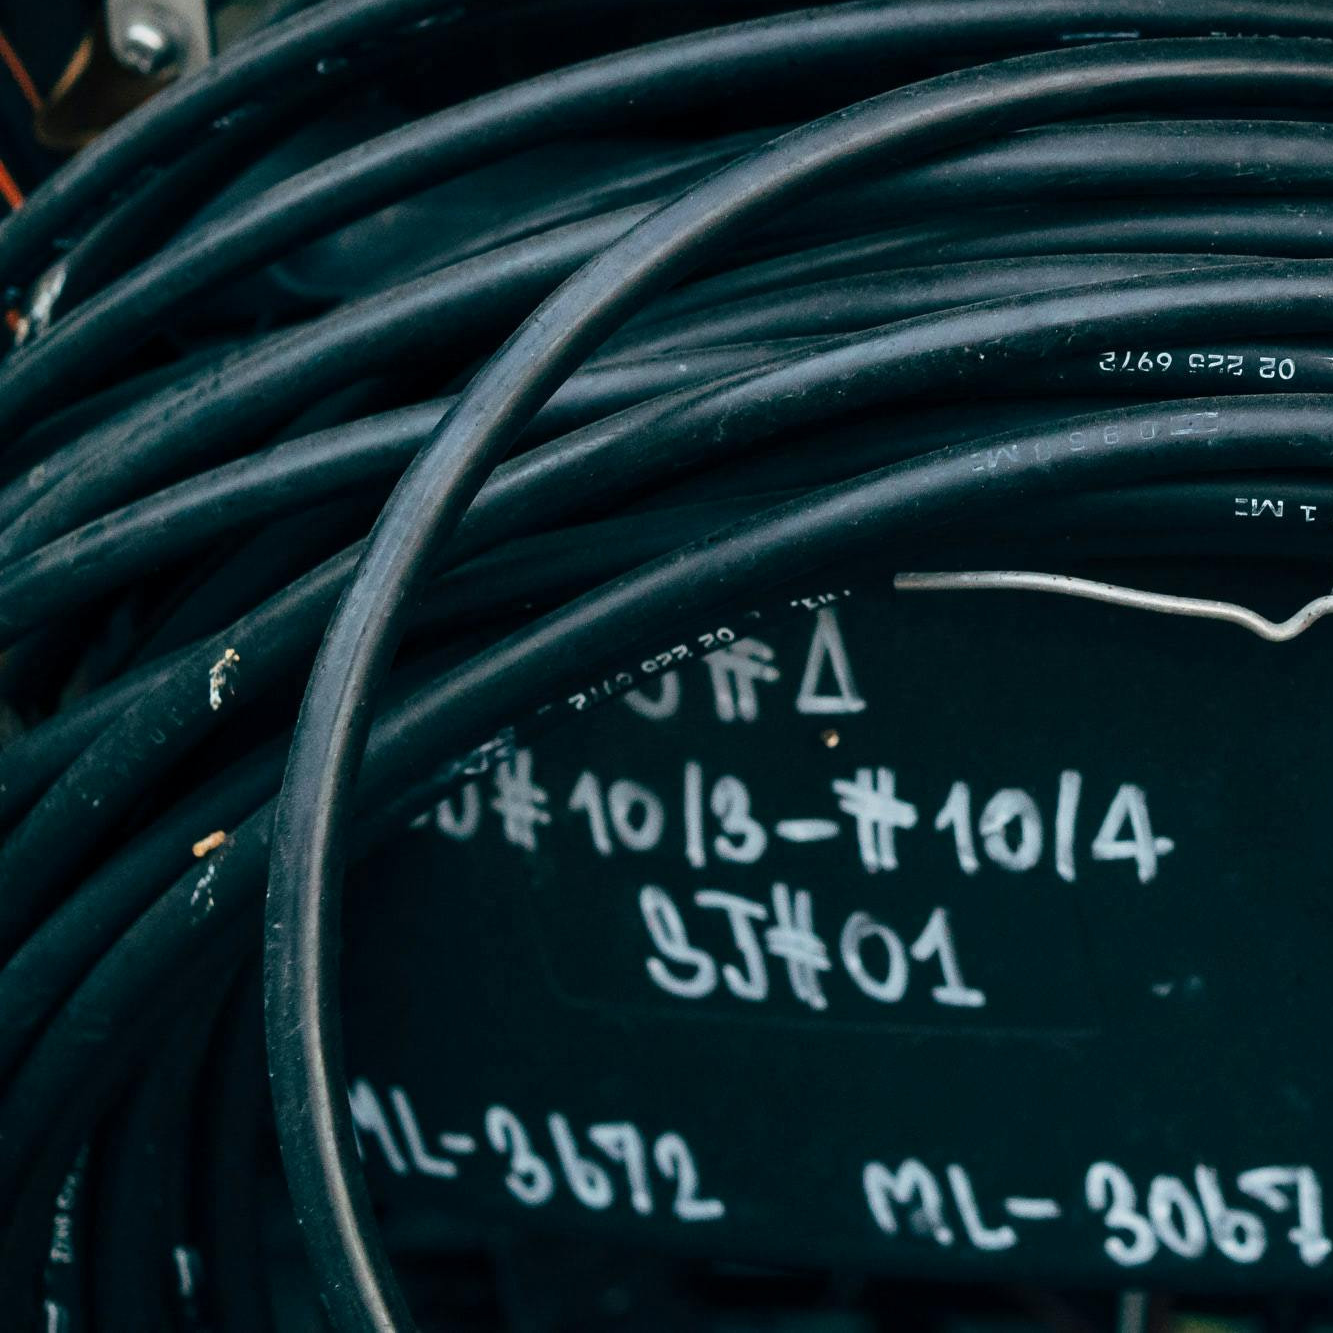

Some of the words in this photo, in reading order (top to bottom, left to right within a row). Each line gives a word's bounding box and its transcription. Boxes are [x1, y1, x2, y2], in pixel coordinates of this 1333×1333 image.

[1098, 350, 1175, 374] 6972
[1258, 355, 1297, 382] 02
[350, 1077, 726, 1221] ML-3672
